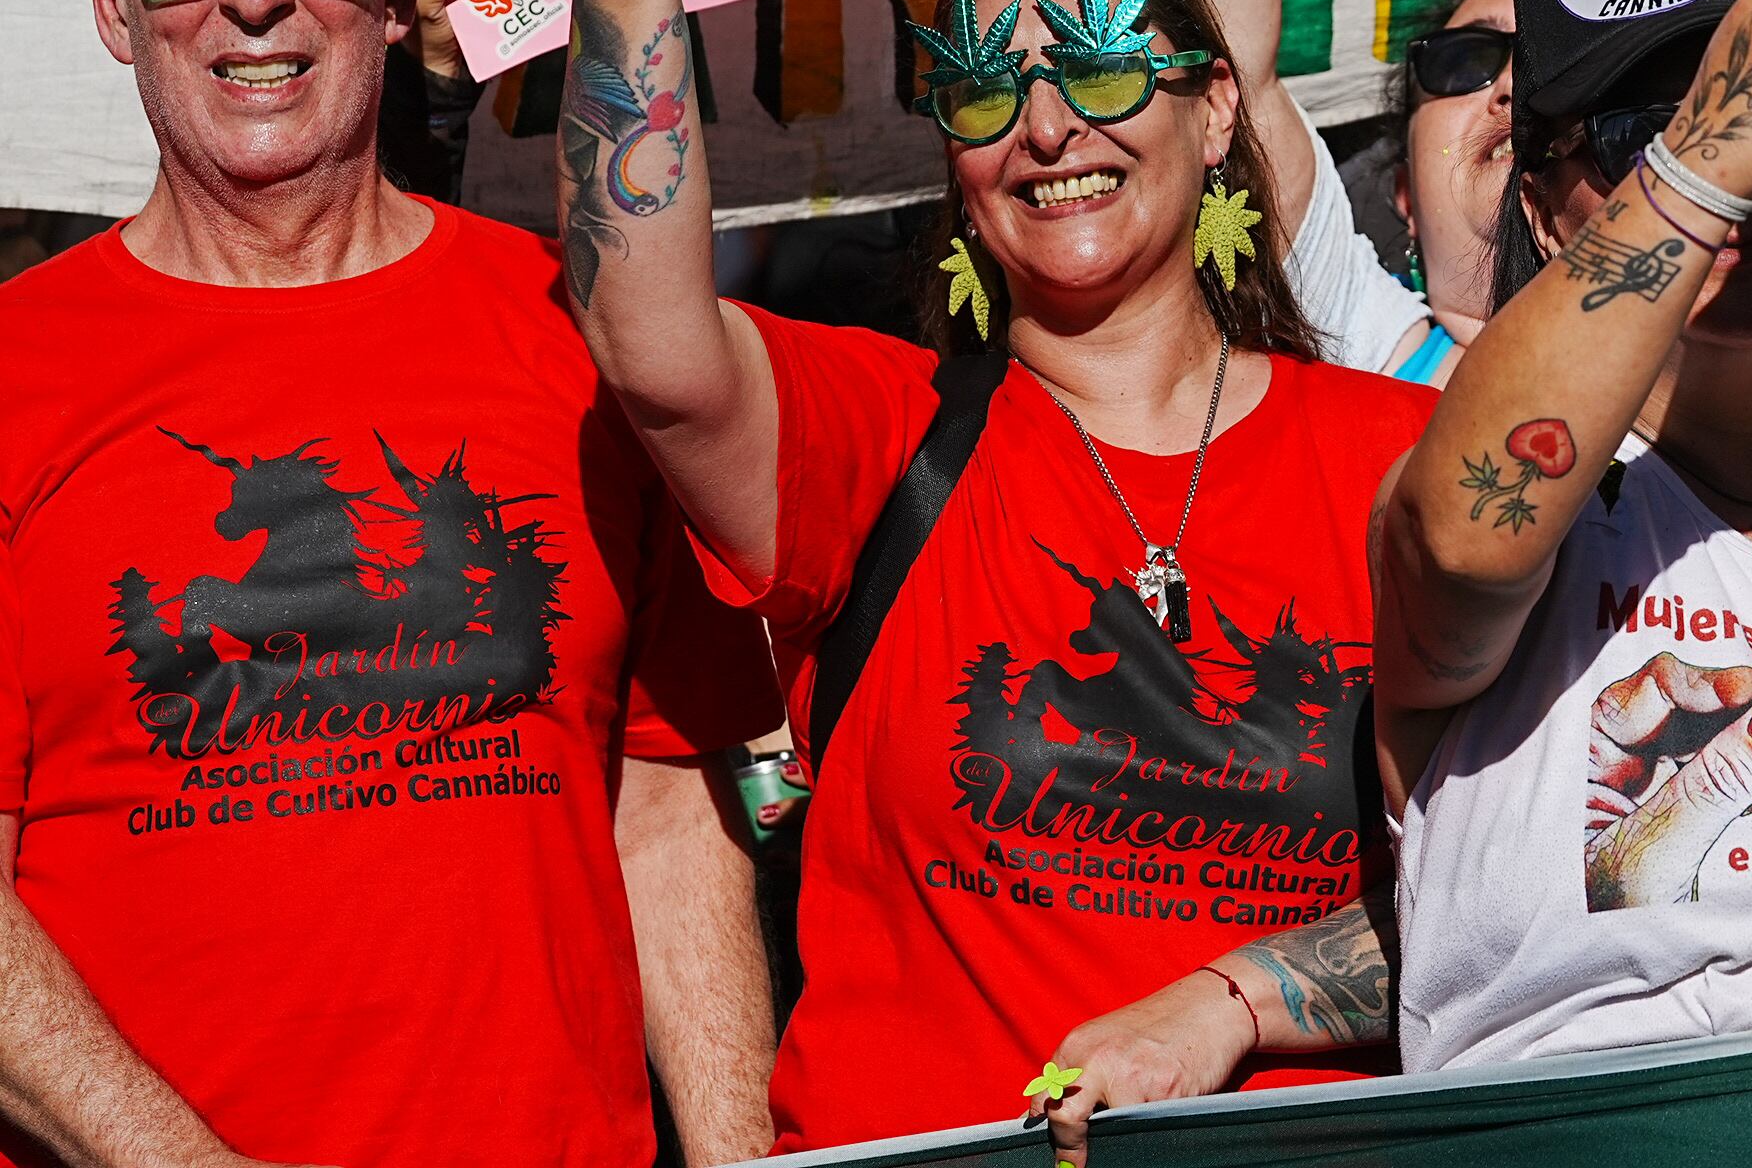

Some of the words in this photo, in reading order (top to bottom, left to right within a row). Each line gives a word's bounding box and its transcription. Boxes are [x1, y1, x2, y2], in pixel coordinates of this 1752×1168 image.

[503, 0, 545, 35] CEC
[264, 624, 468, 699] Jardín
[137, 678, 527, 760] Unicornio
[180, 745, 383, 792] Asociación
[395, 729, 521, 769] Cultural
[1090, 727, 1301, 794] Jardín
[127, 800, 196, 836] Club
[208, 789, 254, 823] de
[266, 780, 397, 817] Cultivo
[407, 764, 561, 802] Cannábico
[951, 751, 1360, 866] Unicornio
[923, 859, 999, 899] Club
[1010, 875, 1054, 909] de
[1066, 883, 1198, 924] Cultivo
[984, 838, 1186, 887] Asociación
[1199, 861, 1351, 898] Cultural
